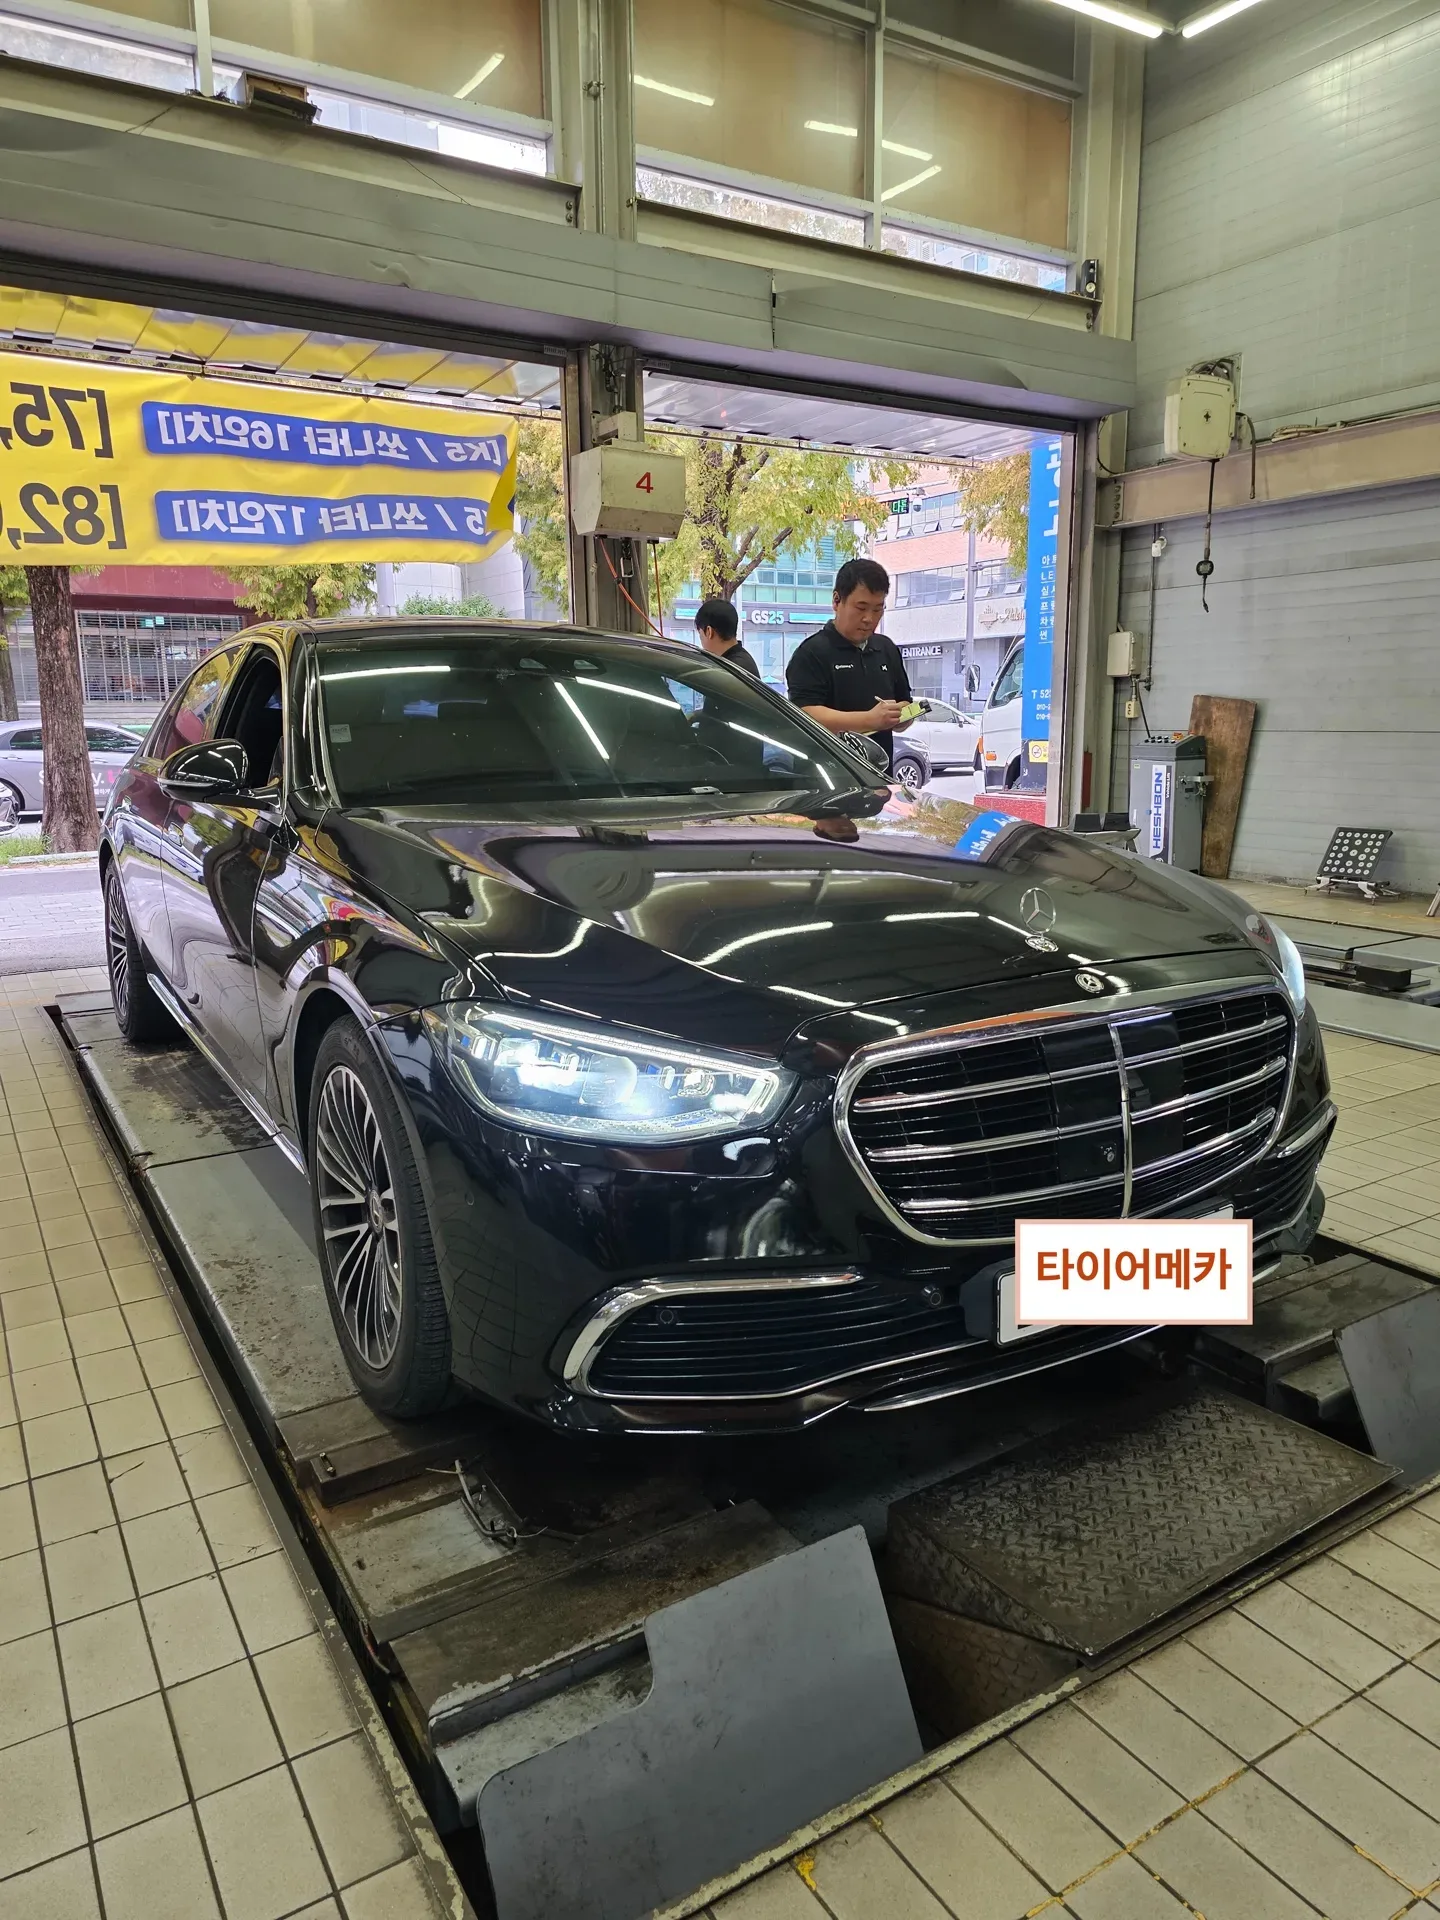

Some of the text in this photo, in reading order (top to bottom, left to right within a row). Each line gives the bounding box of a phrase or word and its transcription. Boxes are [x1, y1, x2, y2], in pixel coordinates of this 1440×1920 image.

[636, 472, 654, 493] 4
[751, 609, 785, 625] GS25
[902, 645, 942, 657] ENTRANCE
[1153, 773, 1162, 849] HESHBON
